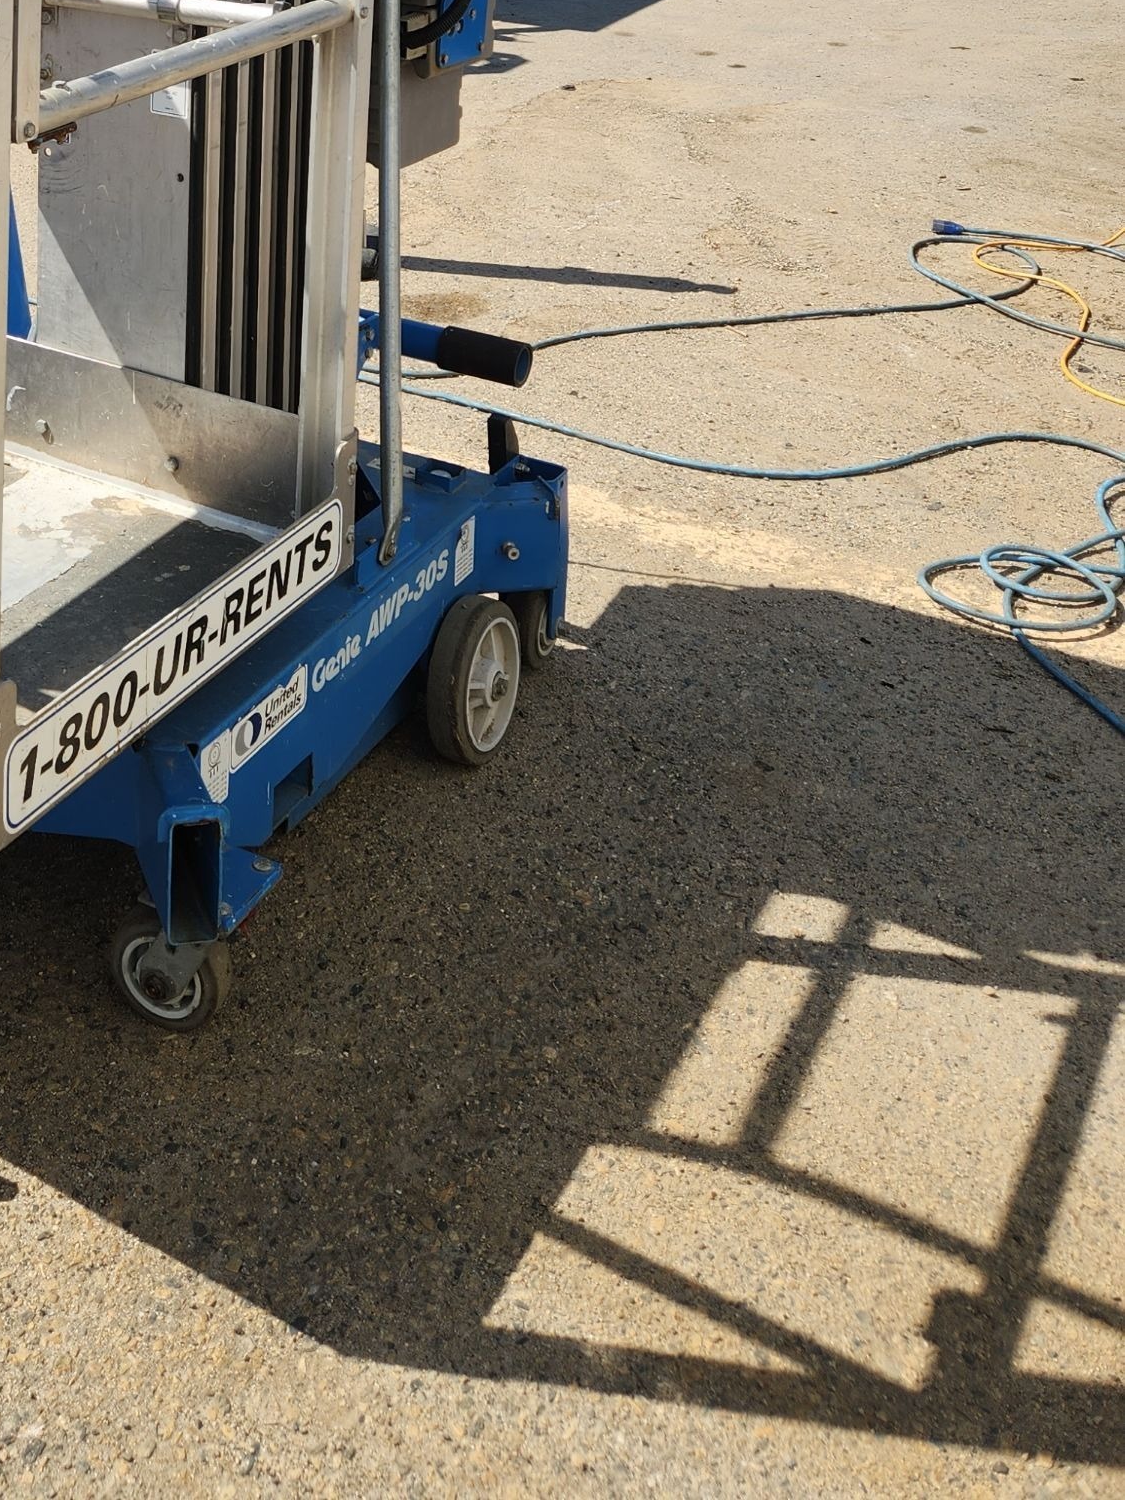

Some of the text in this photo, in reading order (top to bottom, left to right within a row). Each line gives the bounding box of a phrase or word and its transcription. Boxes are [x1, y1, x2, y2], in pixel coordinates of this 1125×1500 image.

[19, 519, 333, 804] 1-800-UR-RENTS
[312, 549, 449, 692] Genie AWP-30S
[264, 677, 300, 717] United
[265, 694, 302, 735] Rentals
